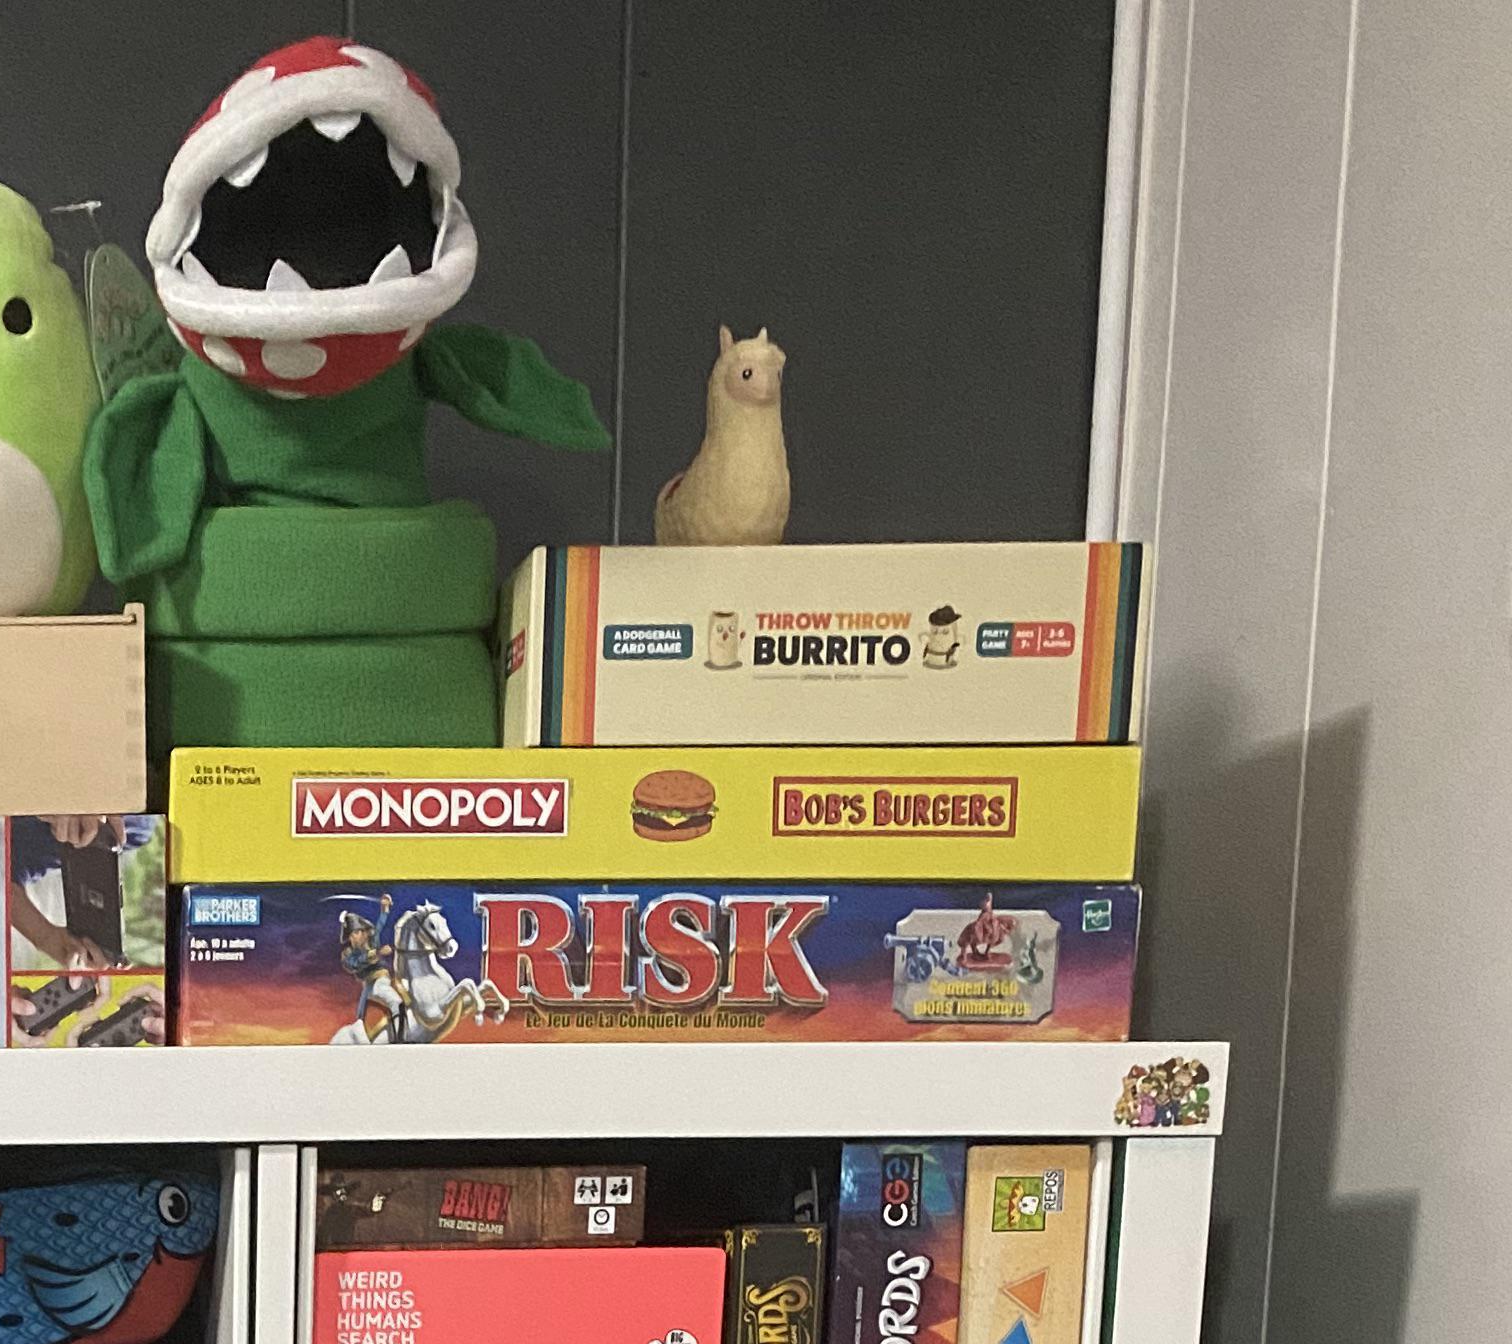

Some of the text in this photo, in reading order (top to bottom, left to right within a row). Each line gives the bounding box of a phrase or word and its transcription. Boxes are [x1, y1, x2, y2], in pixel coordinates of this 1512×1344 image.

[756, 611, 912, 630] THROW THROW
[612, 642, 682, 654] CARD GAME
[753, 634, 912, 666] BURRITO
[302, 787, 560, 829] MONOPOLY
[784, 789, 1006, 827] BOB'S BURGERS
[211, 898, 257, 912] PARKER
[194, 911, 257, 923] BROTHERS
[473, 892, 830, 1008] RISK
[440, 1179, 511, 1222] BANG!
[1044, 1170, 1058, 1212] REPOS
[338, 1271, 403, 1290] WEIRD
[338, 1291, 414, 1310] THINGS
[337, 1311, 422, 1330] HUMANS
